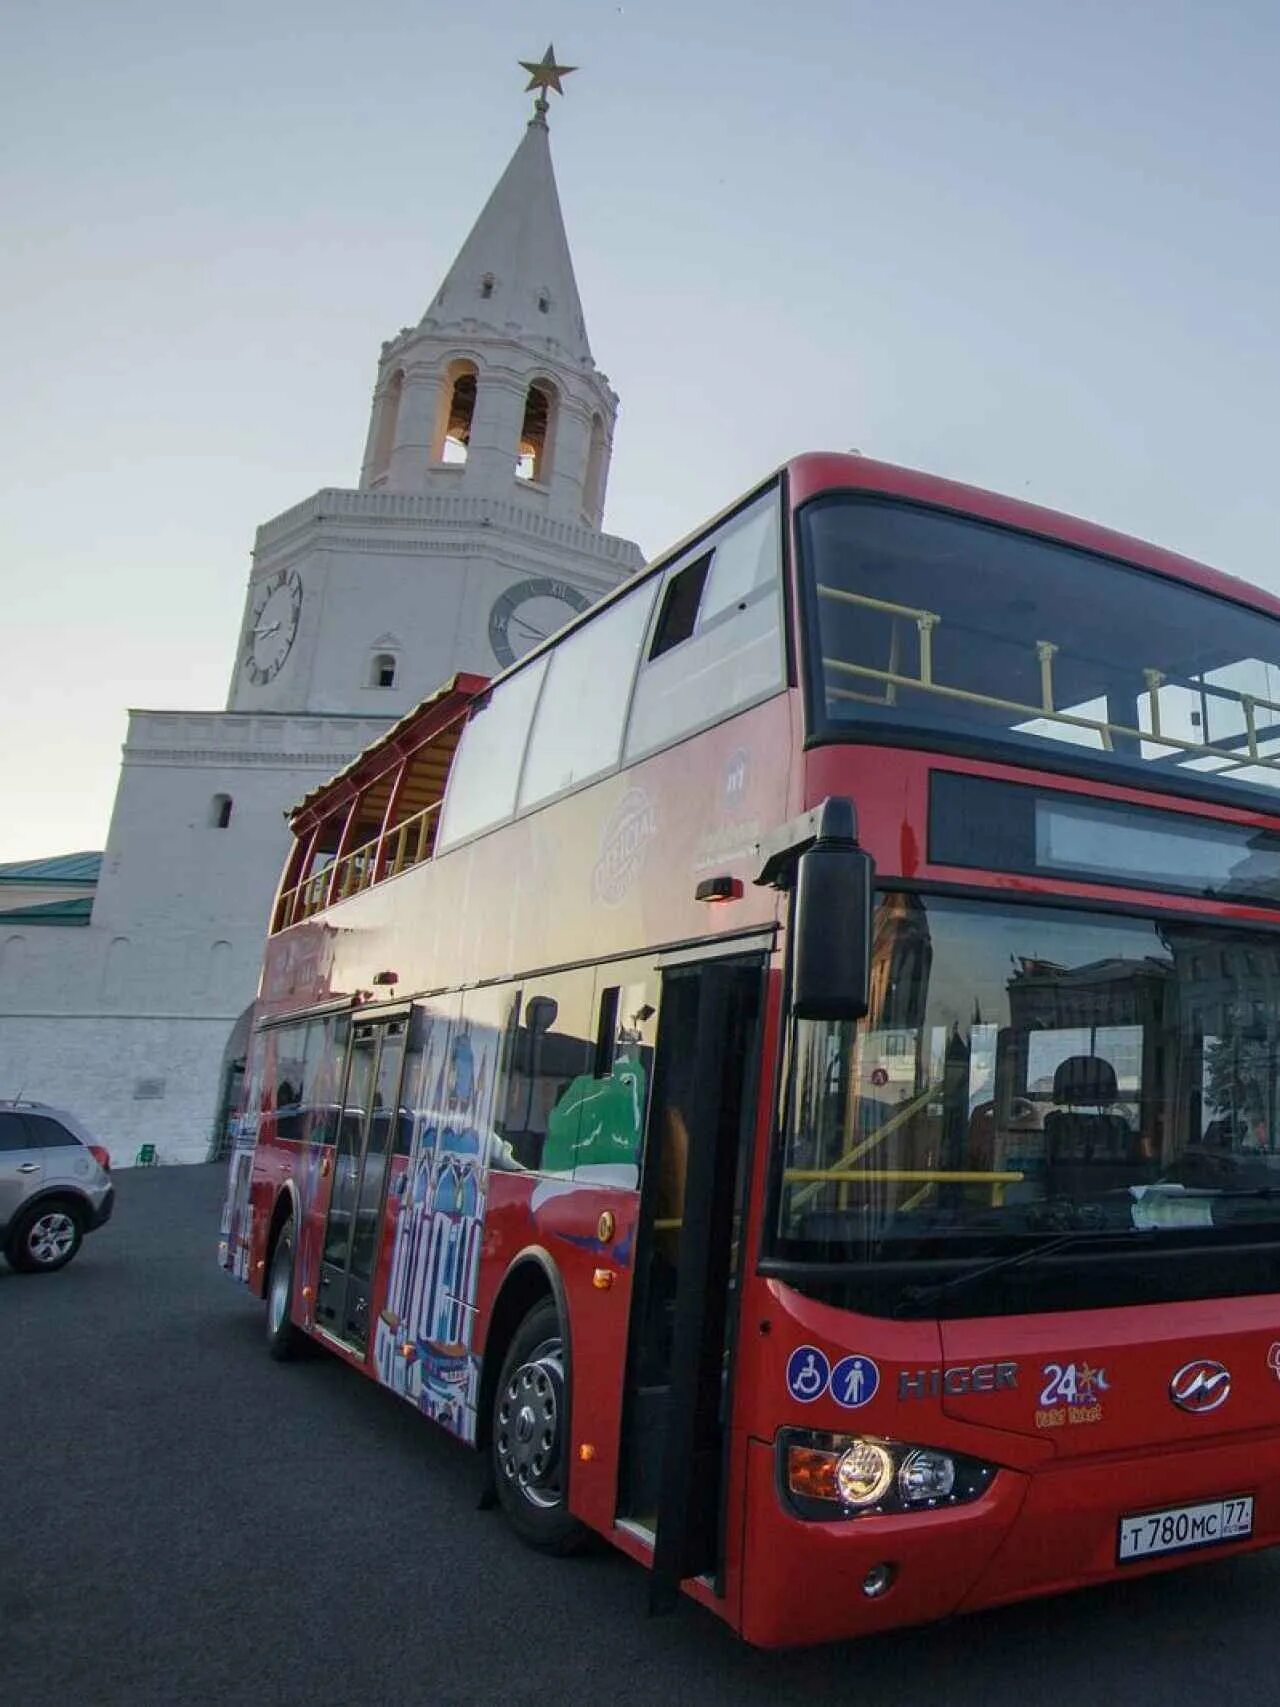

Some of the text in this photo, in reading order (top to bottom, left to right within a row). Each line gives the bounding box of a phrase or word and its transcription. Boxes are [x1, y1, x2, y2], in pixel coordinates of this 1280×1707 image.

[898, 1362, 1018, 1402] HIGER
[1040, 1364, 1077, 1406] 24
[1225, 1502, 1246, 1524] 77
